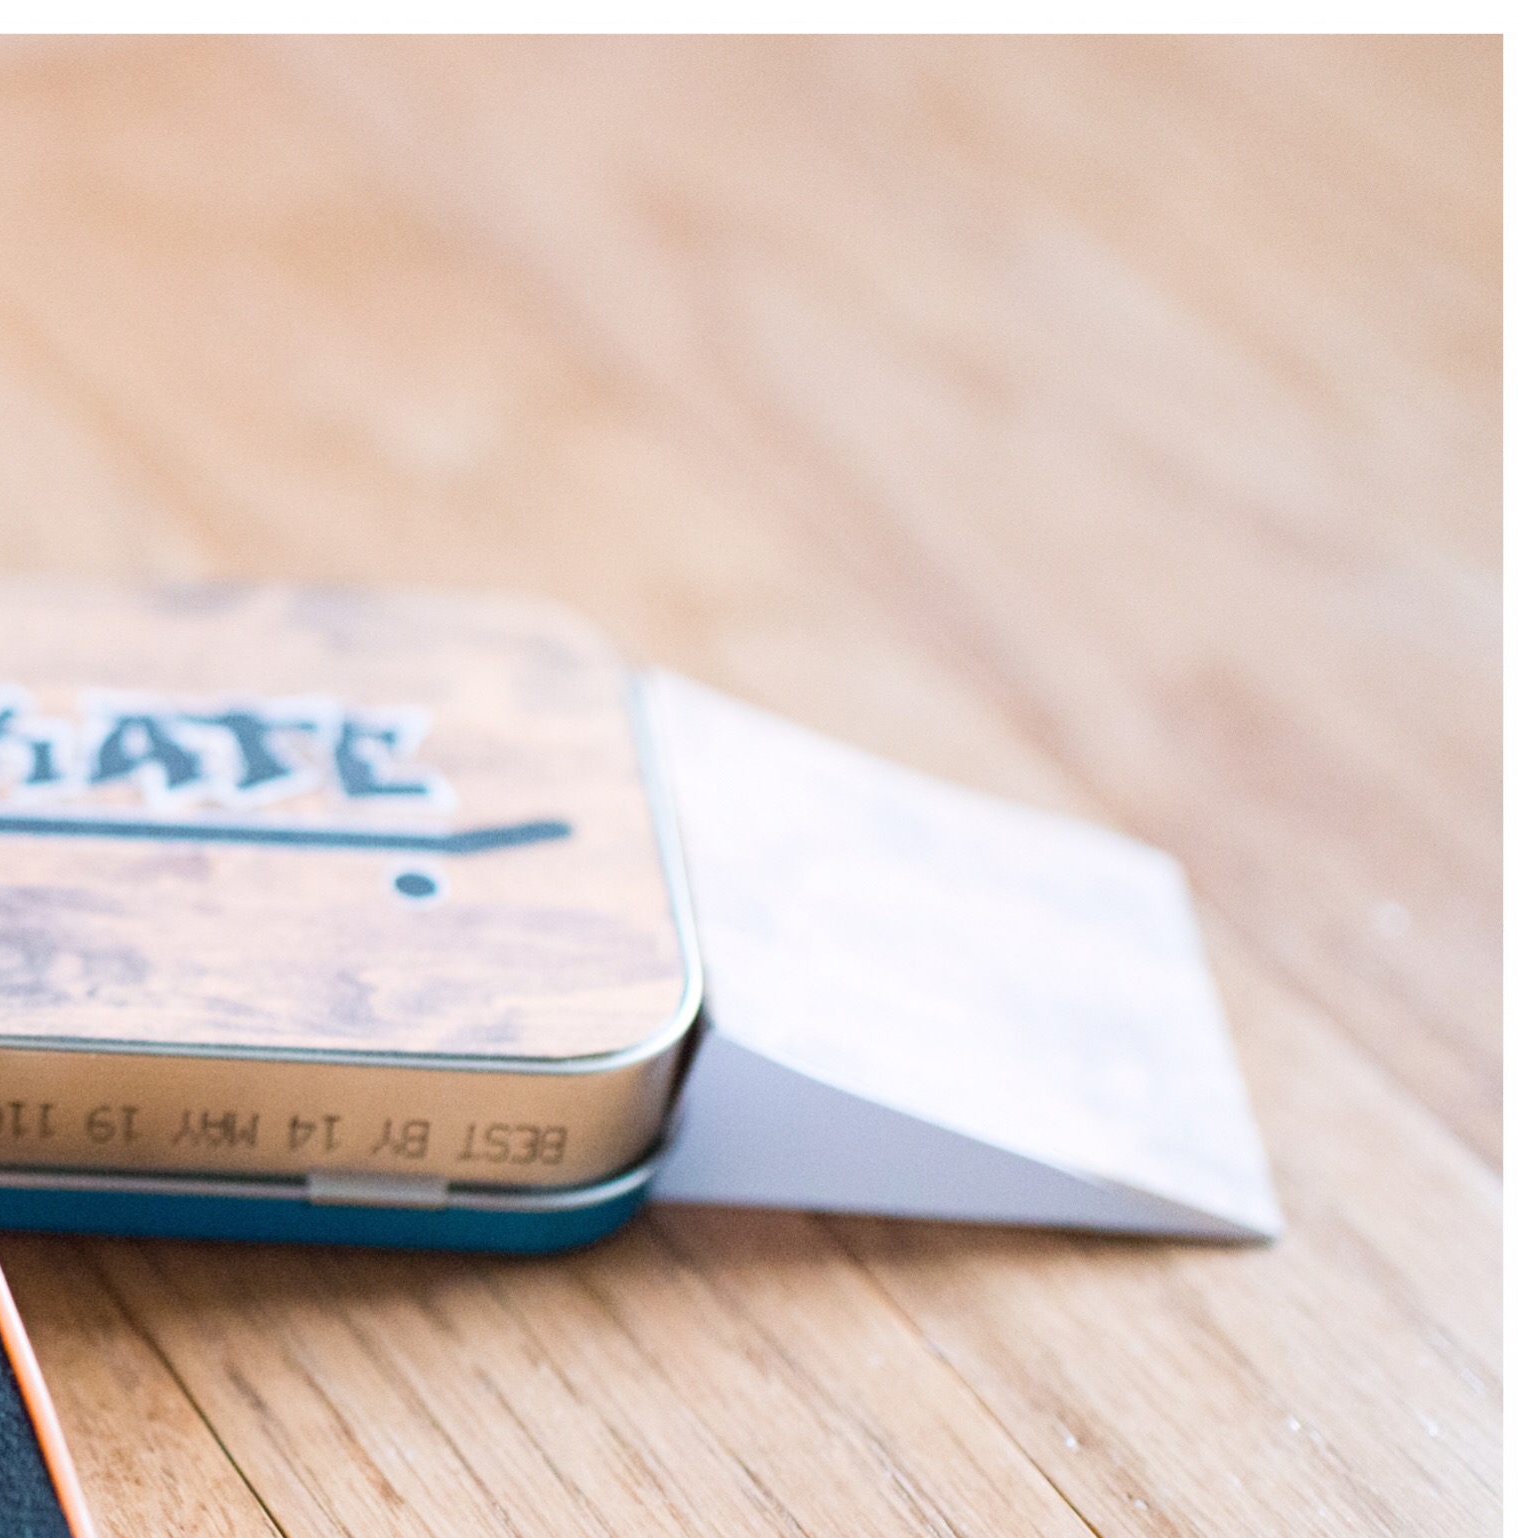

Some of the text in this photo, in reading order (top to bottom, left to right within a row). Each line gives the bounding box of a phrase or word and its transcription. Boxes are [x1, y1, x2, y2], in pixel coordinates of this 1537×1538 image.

[84, 1104, 140, 1146] 19
[170, 1109, 261, 1149] MAY
[288, 1113, 341, 1152] 14
[371, 1116, 432, 1161] BY
[457, 1120, 569, 1166] BEST
